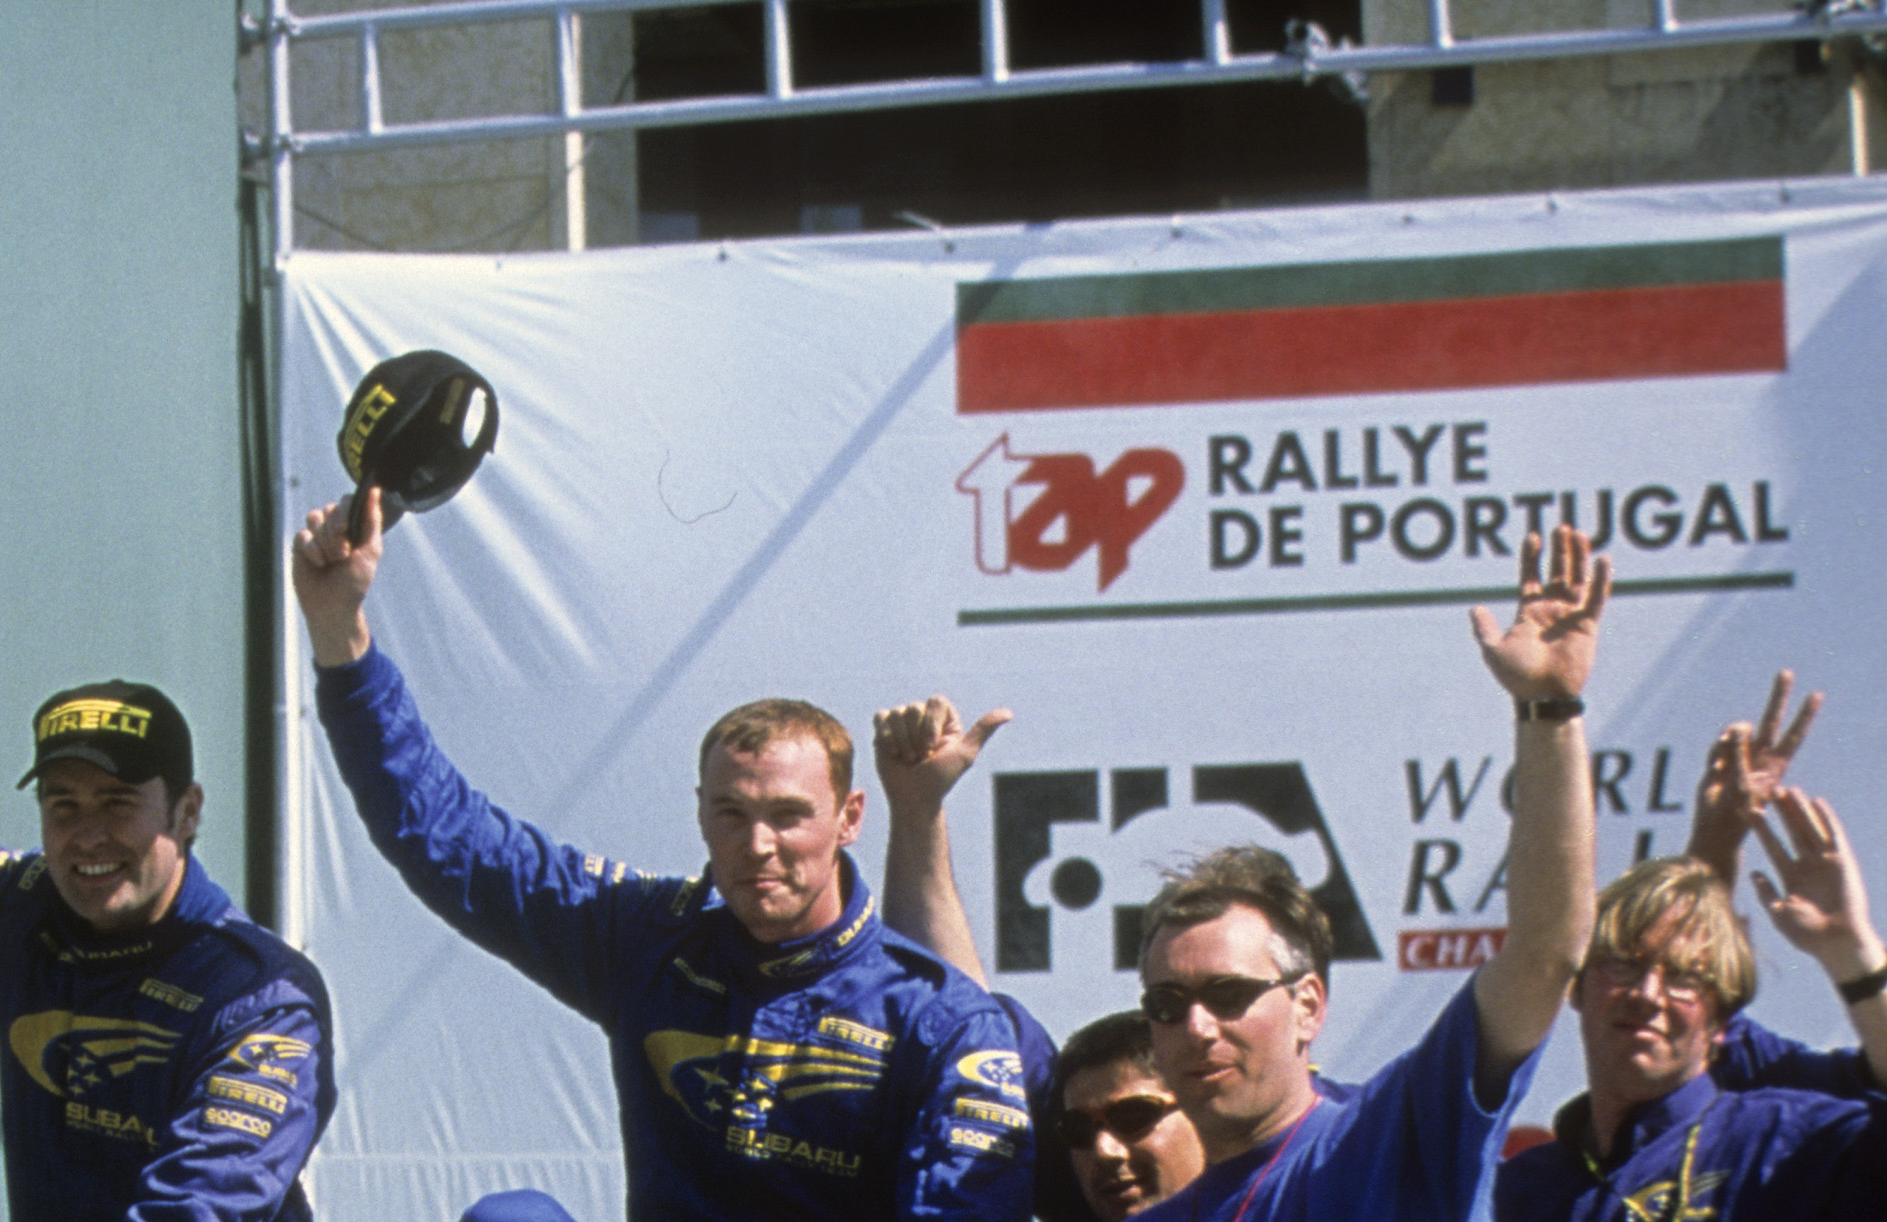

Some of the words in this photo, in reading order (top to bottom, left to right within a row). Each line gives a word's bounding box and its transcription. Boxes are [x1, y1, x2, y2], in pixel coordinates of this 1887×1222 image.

[1209, 422, 1489, 494] RALLYE
[1210, 506, 1304, 569] DE
[1340, 481, 1789, 563] PORTUGAL
[39, 698, 153, 742] PIRELLI
[1405, 748, 1683, 824] WRL
[818, 1016, 896, 1052] PIRELLI
[208, 1075, 288, 1115] PIRELLI
[726, 1126, 862, 1170] SUBARU
